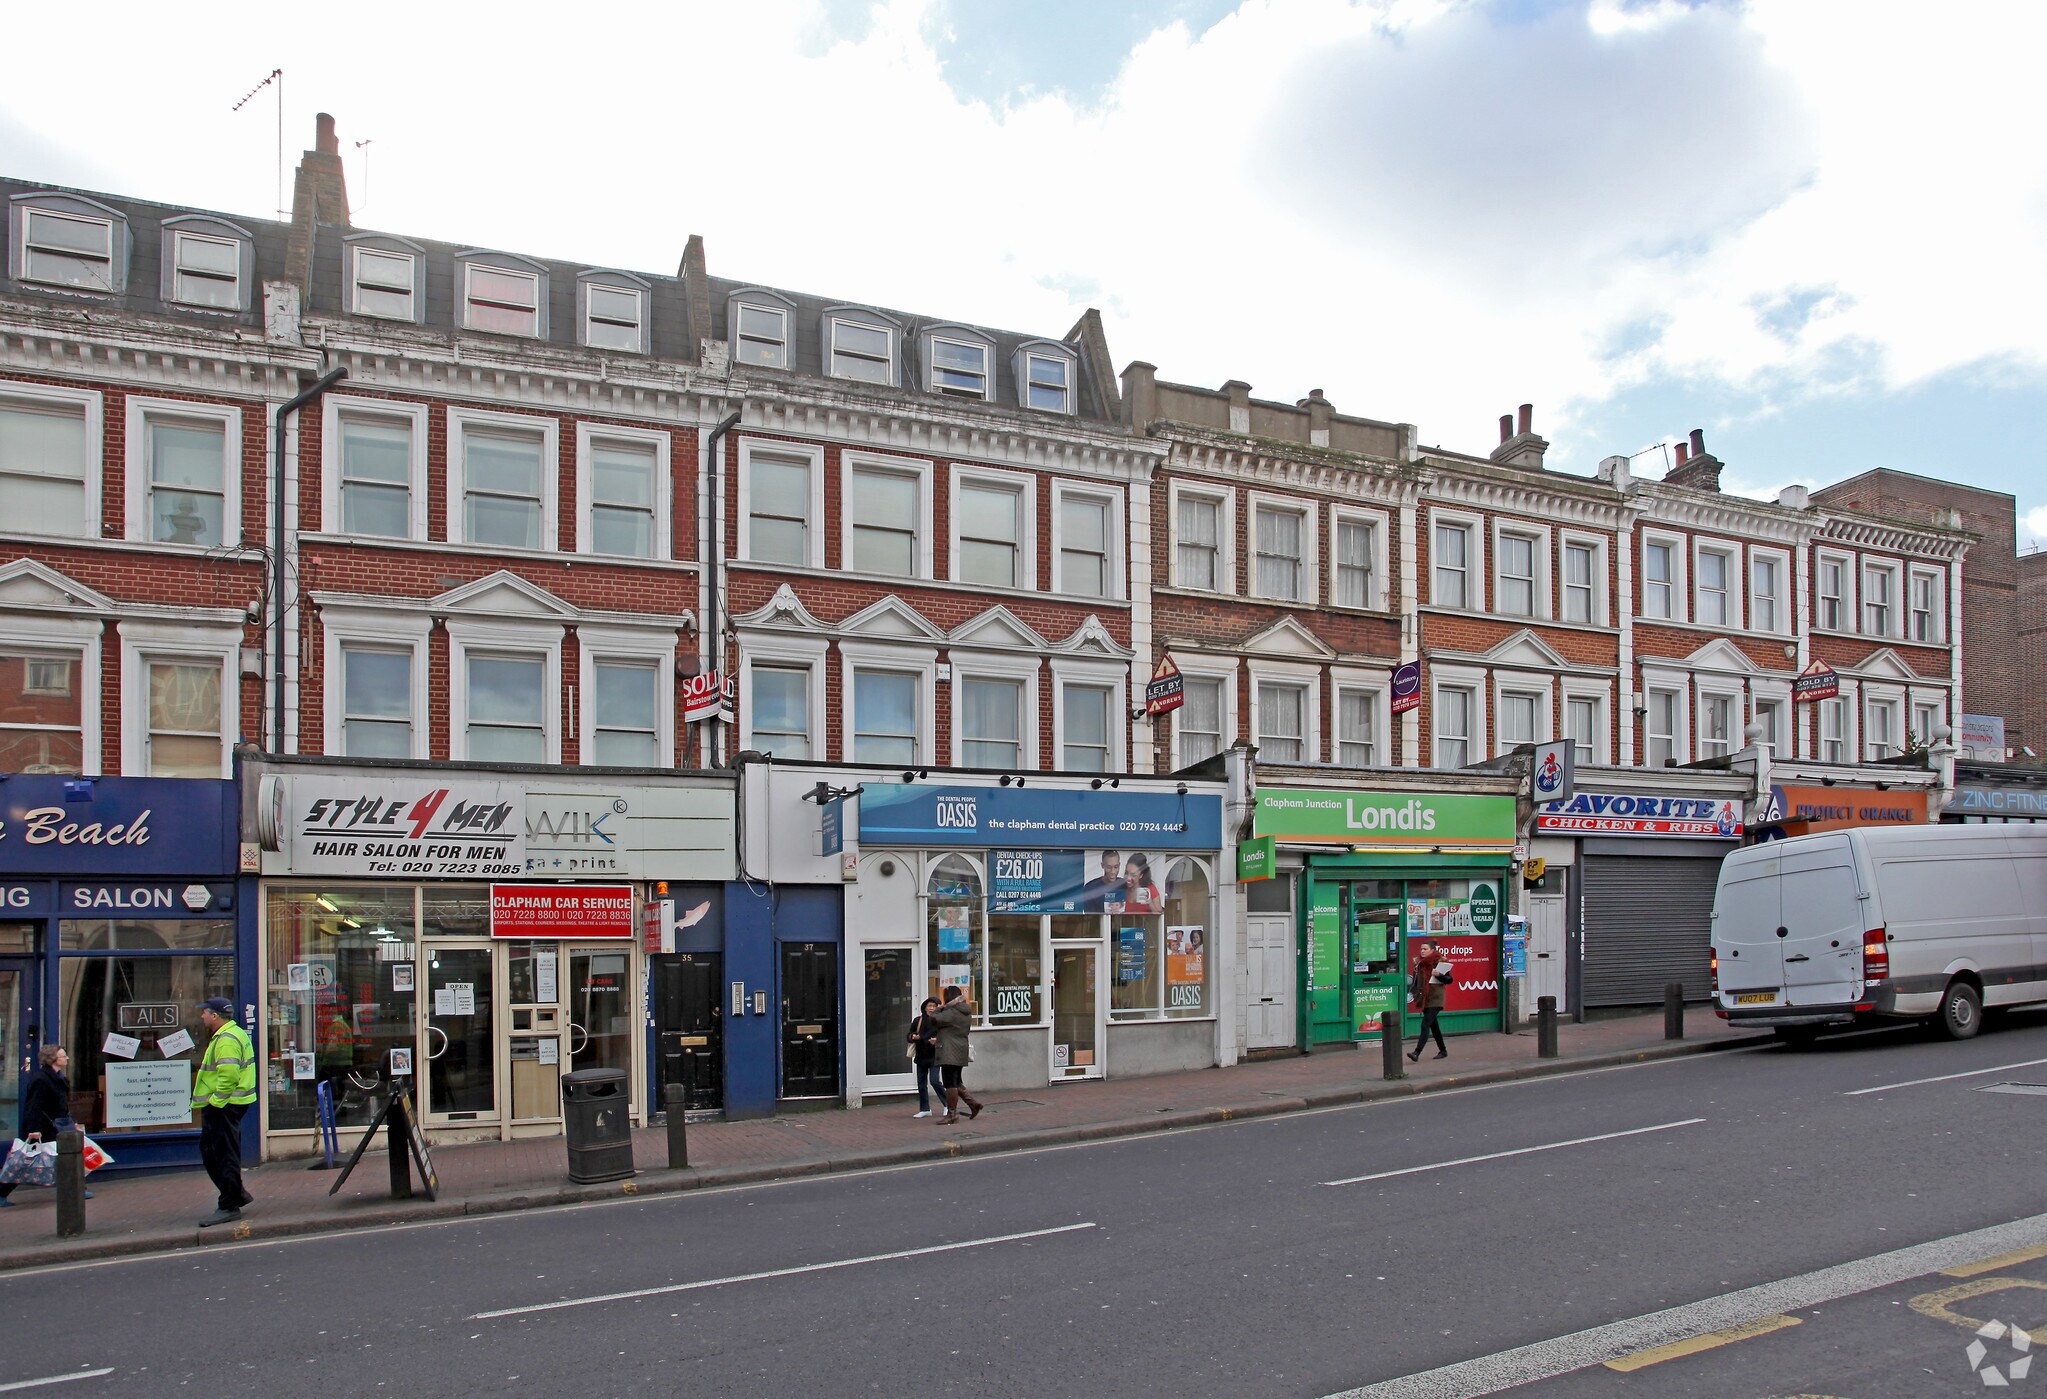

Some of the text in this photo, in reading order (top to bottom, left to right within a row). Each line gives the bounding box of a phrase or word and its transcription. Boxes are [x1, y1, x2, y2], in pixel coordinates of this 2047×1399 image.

[1148, 684, 1164, 695] LET
[1168, 680, 1180, 690] BY
[1546, 794, 1716, 818] FAVORITE
[1962, 790, 2003, 808] ZINC
[303, 795, 409, 828] STYLE
[407, 789, 449, 839] 4
[442, 798, 514, 833] MEN
[937, 803, 976, 827] OASIS
[1264, 797, 1436, 831] Clapham Junction Londis
[1797, 804, 1913, 821] PROJECT ORANGE
[24, 807, 151, 845] Beach
[989, 819, 1115, 832] the clapham dental practice
[1120, 823, 1136, 831] 020
[1139, 823, 1160, 831] 7924
[1545, 818, 1714, 833] CHICKEN & RIBS
[312, 842, 506, 860] HAIR SALON FOR MEN
[1243, 850, 1264, 862] Londis
[368, 861, 521, 874] Tel: 020 7223 8085
[570, 857, 616, 871] print
[996, 860, 1043, 879] £26.00
[74, 888, 172, 908] SALON
[494, 897, 631, 908] CLAPHAM CAR SERVICE
[494, 910, 631, 920] 020 7228 8800 020 7228 8836
[1451, 945, 1473, 956] drops
[998, 991, 1031, 1012] OASIS
[1172, 986, 1201, 1005] OASIS
